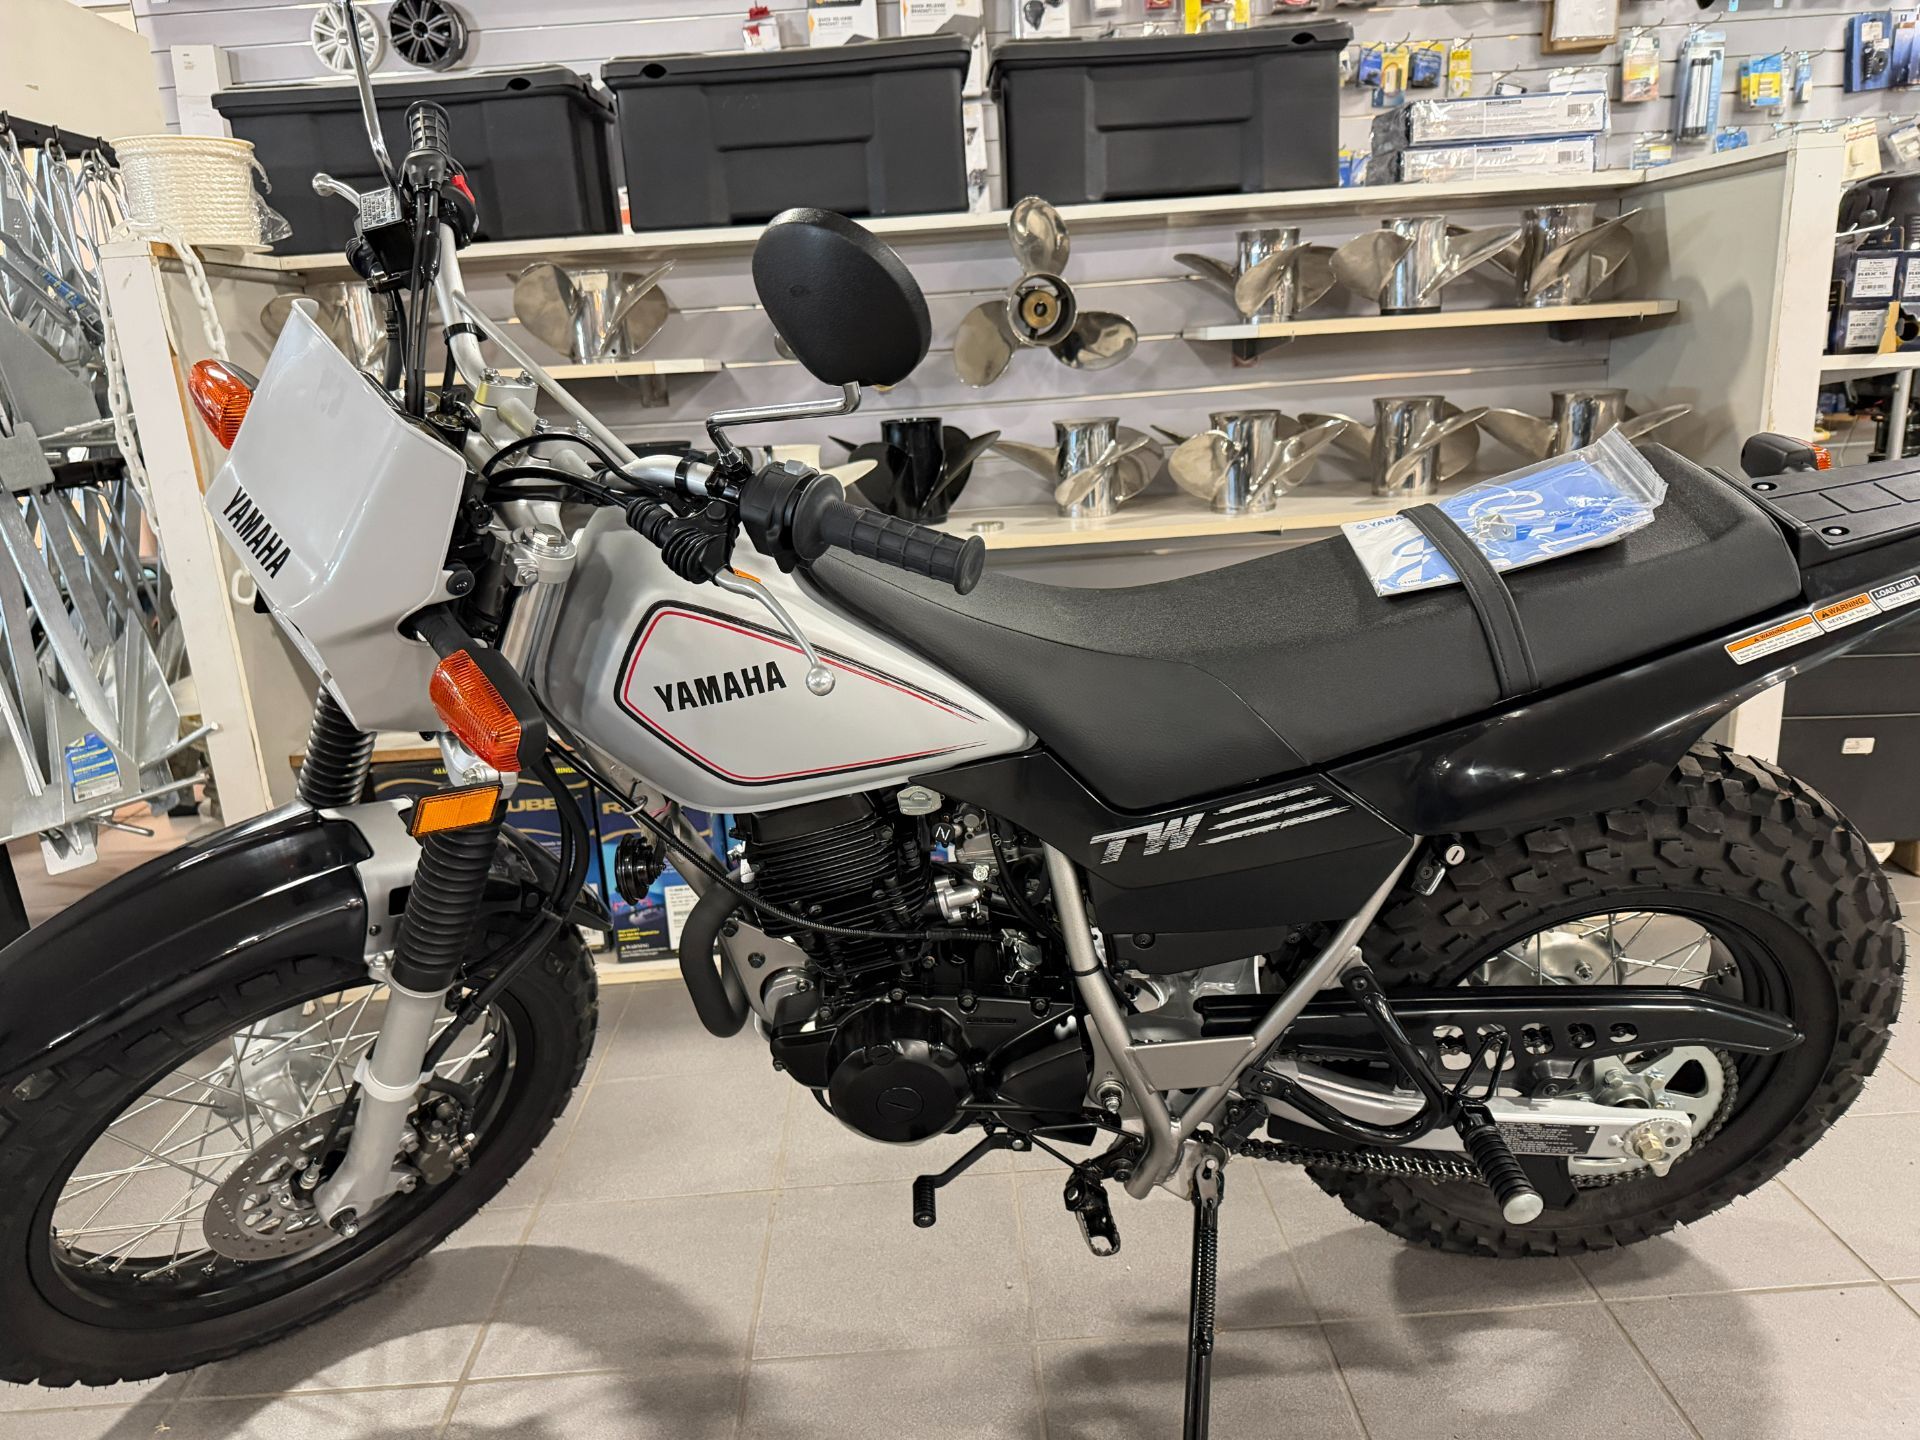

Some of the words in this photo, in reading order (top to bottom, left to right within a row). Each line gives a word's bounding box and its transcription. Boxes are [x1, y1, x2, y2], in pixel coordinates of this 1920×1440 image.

[1369, 514, 1408, 527] YAMA
[222, 485, 292, 580] YAMAHA
[1874, 587, 1897, 598] LOAD
[1896, 579, 1917, 591] LIMIT
[1828, 597, 1865, 615] WARNING
[1760, 627, 1786, 639] WARNING
[653, 660, 787, 713] YAMAHA
[1090, 812, 1206, 865] TW
